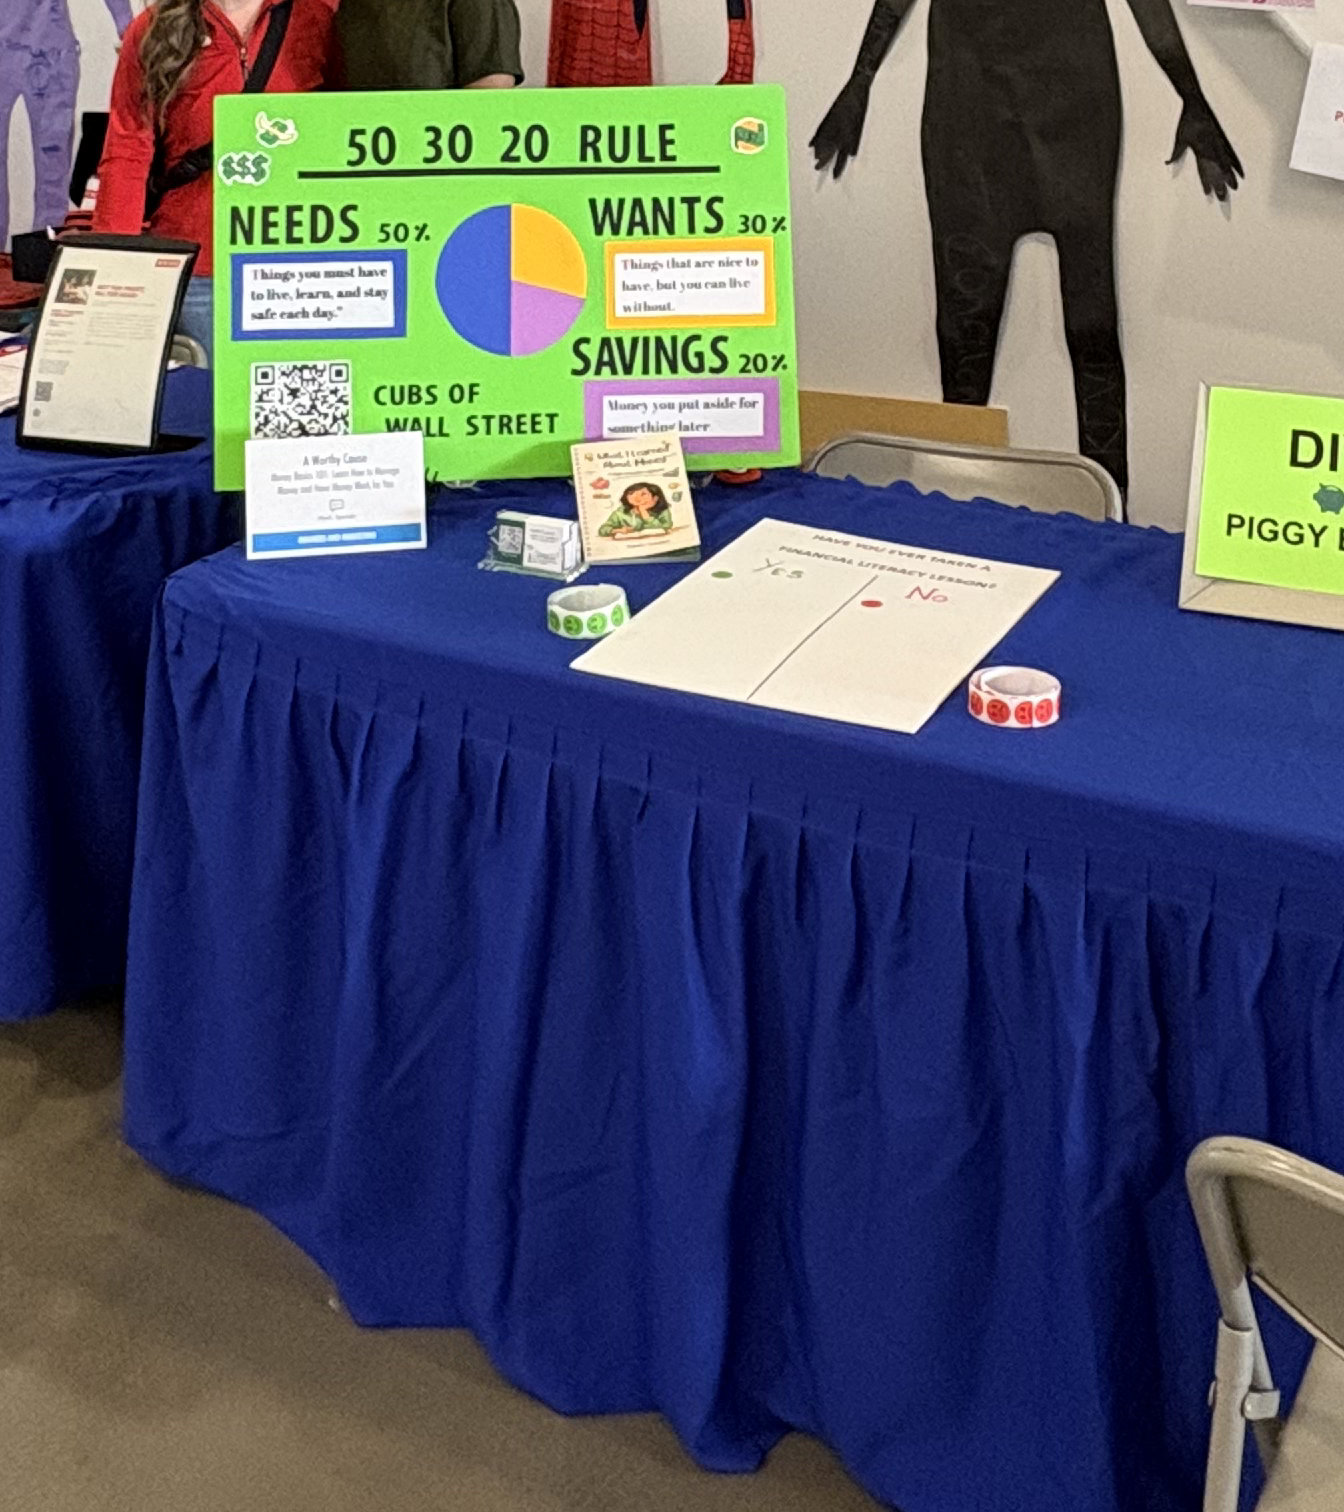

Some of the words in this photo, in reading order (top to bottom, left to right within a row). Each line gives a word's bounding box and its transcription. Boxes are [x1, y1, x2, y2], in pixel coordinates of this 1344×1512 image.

[346, 126, 396, 167] 50
[422, 124, 473, 164] 30
[500, 124, 549, 162] 20
[579, 124, 677, 163] RULE
[230, 204, 360, 245] NEEDS
[378, 223, 431, 243] 50%
[588, 196, 724, 236] WANTS
[737, 215, 787, 234] 30%
[298, 269, 321, 283] you
[323, 268, 355, 278] must
[358, 266, 387, 278] have
[621, 259, 663, 272] Things
[666, 257, 691, 268] that
[694, 259, 715, 268] are
[718, 257, 743, 267] nice
[746, 257, 759, 267] to
[251, 291, 264, 301] to
[336, 286, 361, 298] and
[364, 288, 388, 300] stay
[656, 279, 677, 291] but
[679, 281, 702, 293] you
[704, 280, 726, 289] can
[729, 277, 751, 289] live
[251, 308, 277, 320] safe
[279, 307, 309, 319] each
[571, 335, 728, 376] SAVINGS
[738, 353, 787, 374] 20%
[374, 385, 438, 405] CUBS
[449, 383, 480, 404] OF
[653, 401, 676, 415] you
[678, 399, 700, 414] put
[702, 397, 737, 410] aside
[739, 397, 759, 410] for
[385, 416, 450, 437] WALL
[466, 413, 559, 436] STREET
[678, 420, 711, 432] later
[302, 455, 310, 466] A
[1226, 513, 1330, 549] PIGGY
[778, 545, 854, 566] FINANCIAL
[857, 560, 927, 579] LITERACY
[812, 533, 851, 547] HAVE
[855, 541, 887, 554] YOU
[888, 547, 927, 561] EVER
[929, 555, 978, 570] TAKEN
